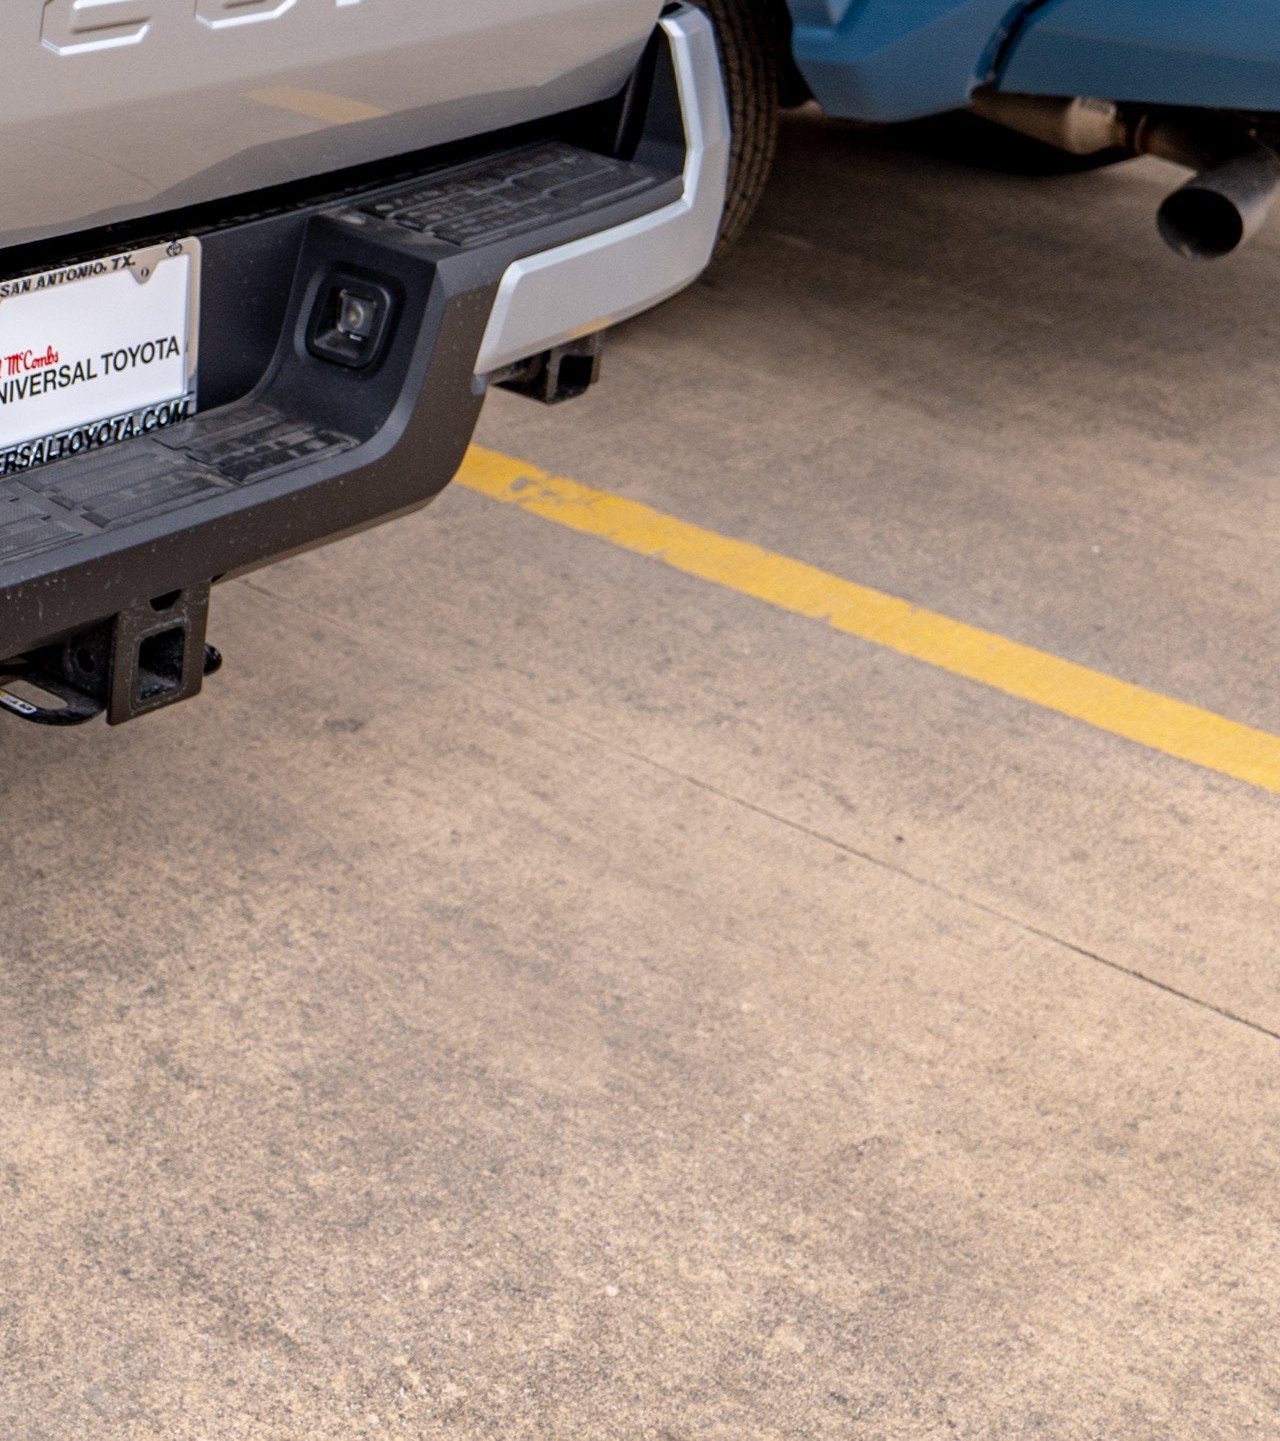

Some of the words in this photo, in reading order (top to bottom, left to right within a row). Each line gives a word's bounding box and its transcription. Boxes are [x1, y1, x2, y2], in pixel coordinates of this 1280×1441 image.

[0, 279, 32, 298] SAN
[4, 345, 60, 375] McCombs
[101, 335, 180, 376] TOYOTA
